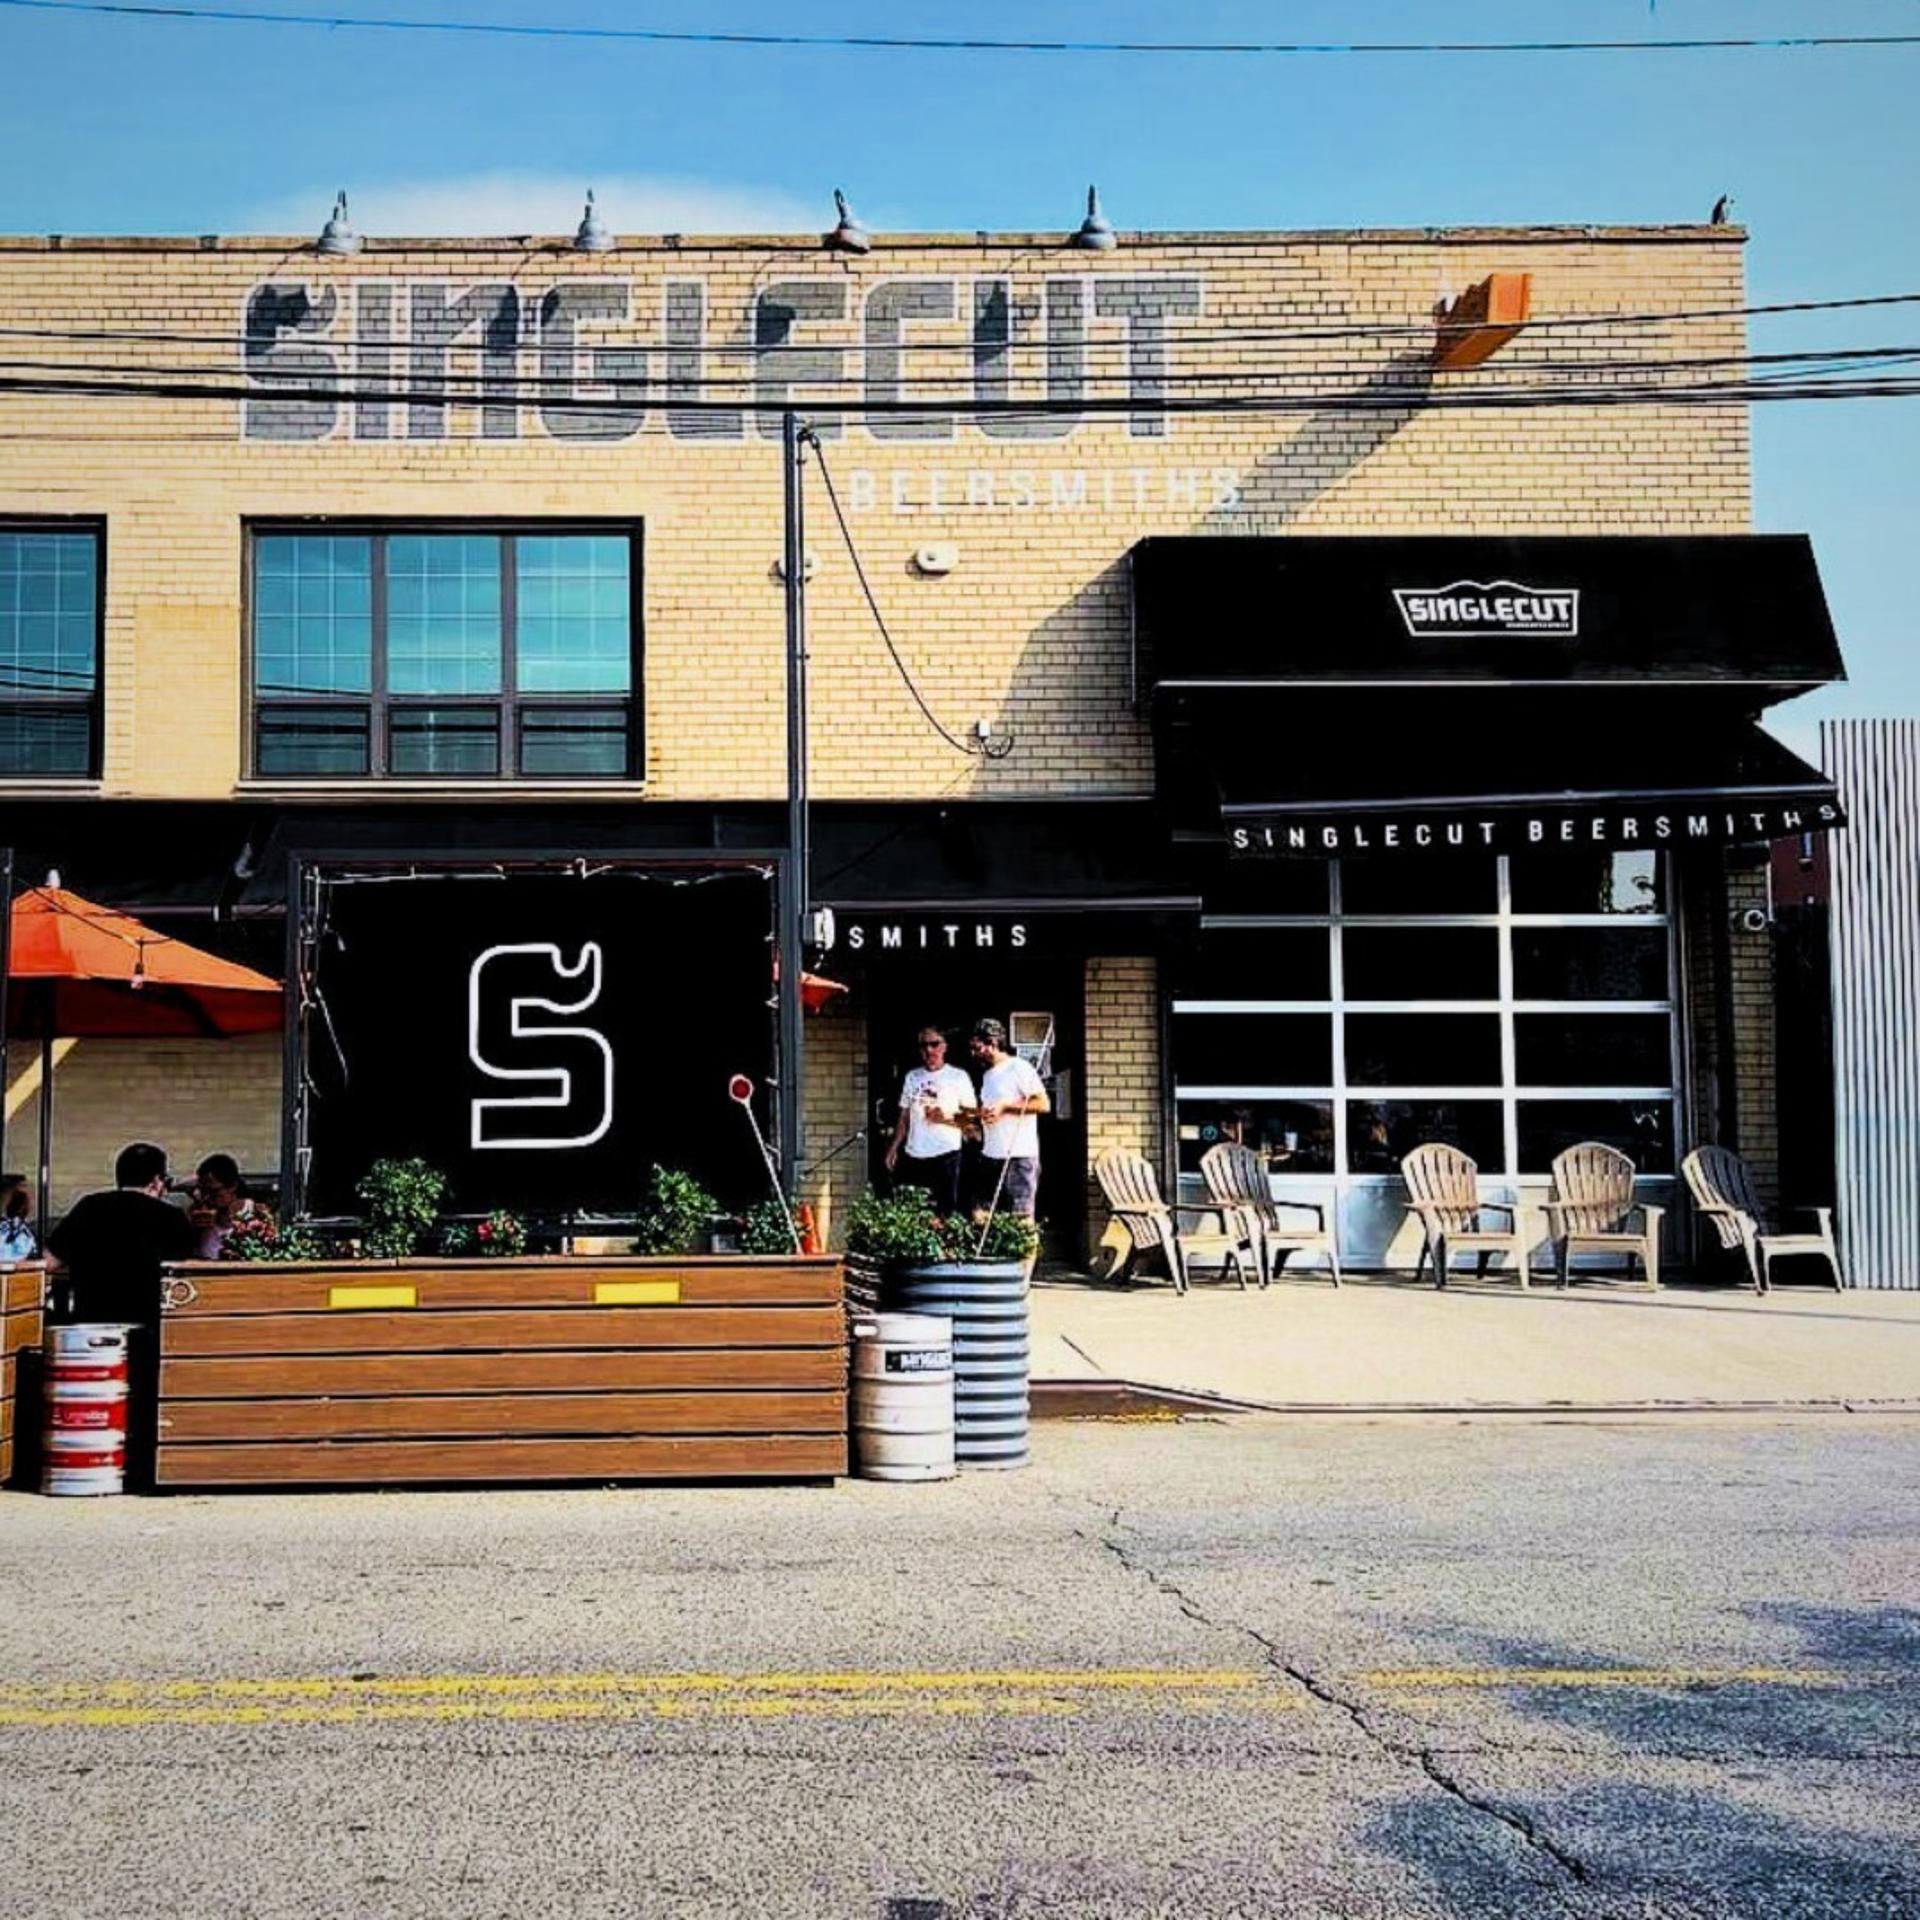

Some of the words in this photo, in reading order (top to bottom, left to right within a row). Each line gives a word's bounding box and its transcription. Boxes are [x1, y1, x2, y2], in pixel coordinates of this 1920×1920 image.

[849, 467, 1241, 513] BEERSMITHS
[1407, 597, 1571, 622] SINGLECUT
[1234, 821, 1494, 849] SINGLECUT
[1527, 804, 1837, 842] BEERSMITHS
